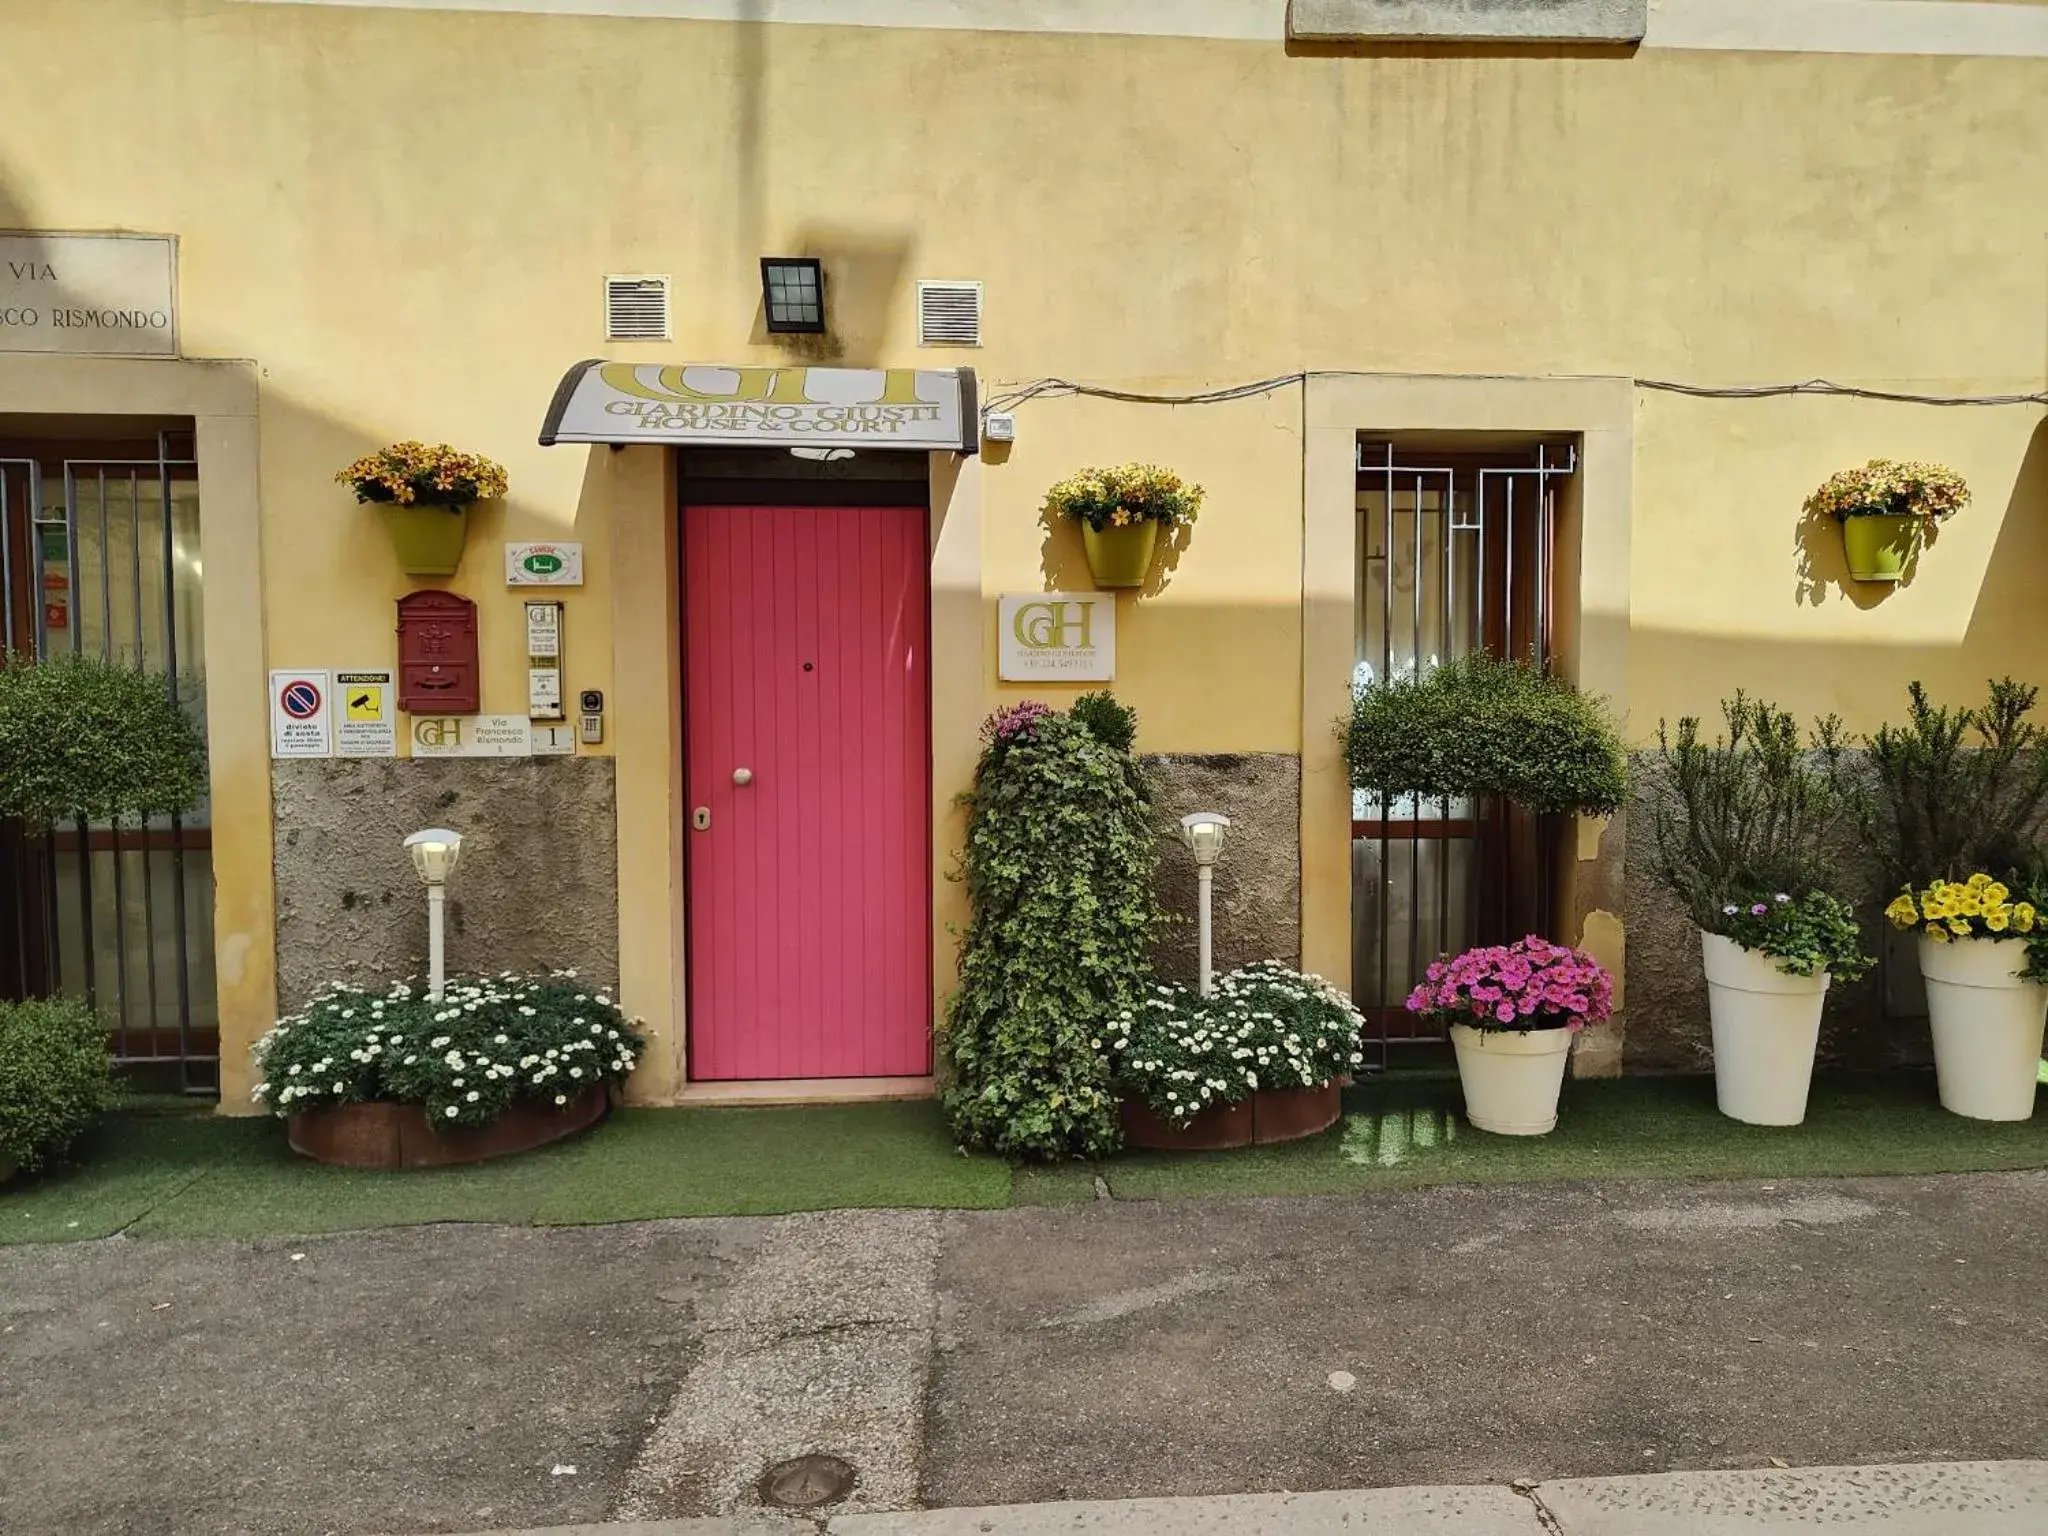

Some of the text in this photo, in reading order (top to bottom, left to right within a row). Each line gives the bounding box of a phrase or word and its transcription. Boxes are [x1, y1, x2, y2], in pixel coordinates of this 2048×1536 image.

[9, 262, 57, 280] VIA
[0, 308, 167, 328] CO RISMONDO
[605, 401, 941, 421] GIARDINO GIUSTI
[638, 416, 906, 433] HOUSE & COURT
[477, 736, 523, 744] Rismondo
[549, 727, 557, 746] 1
